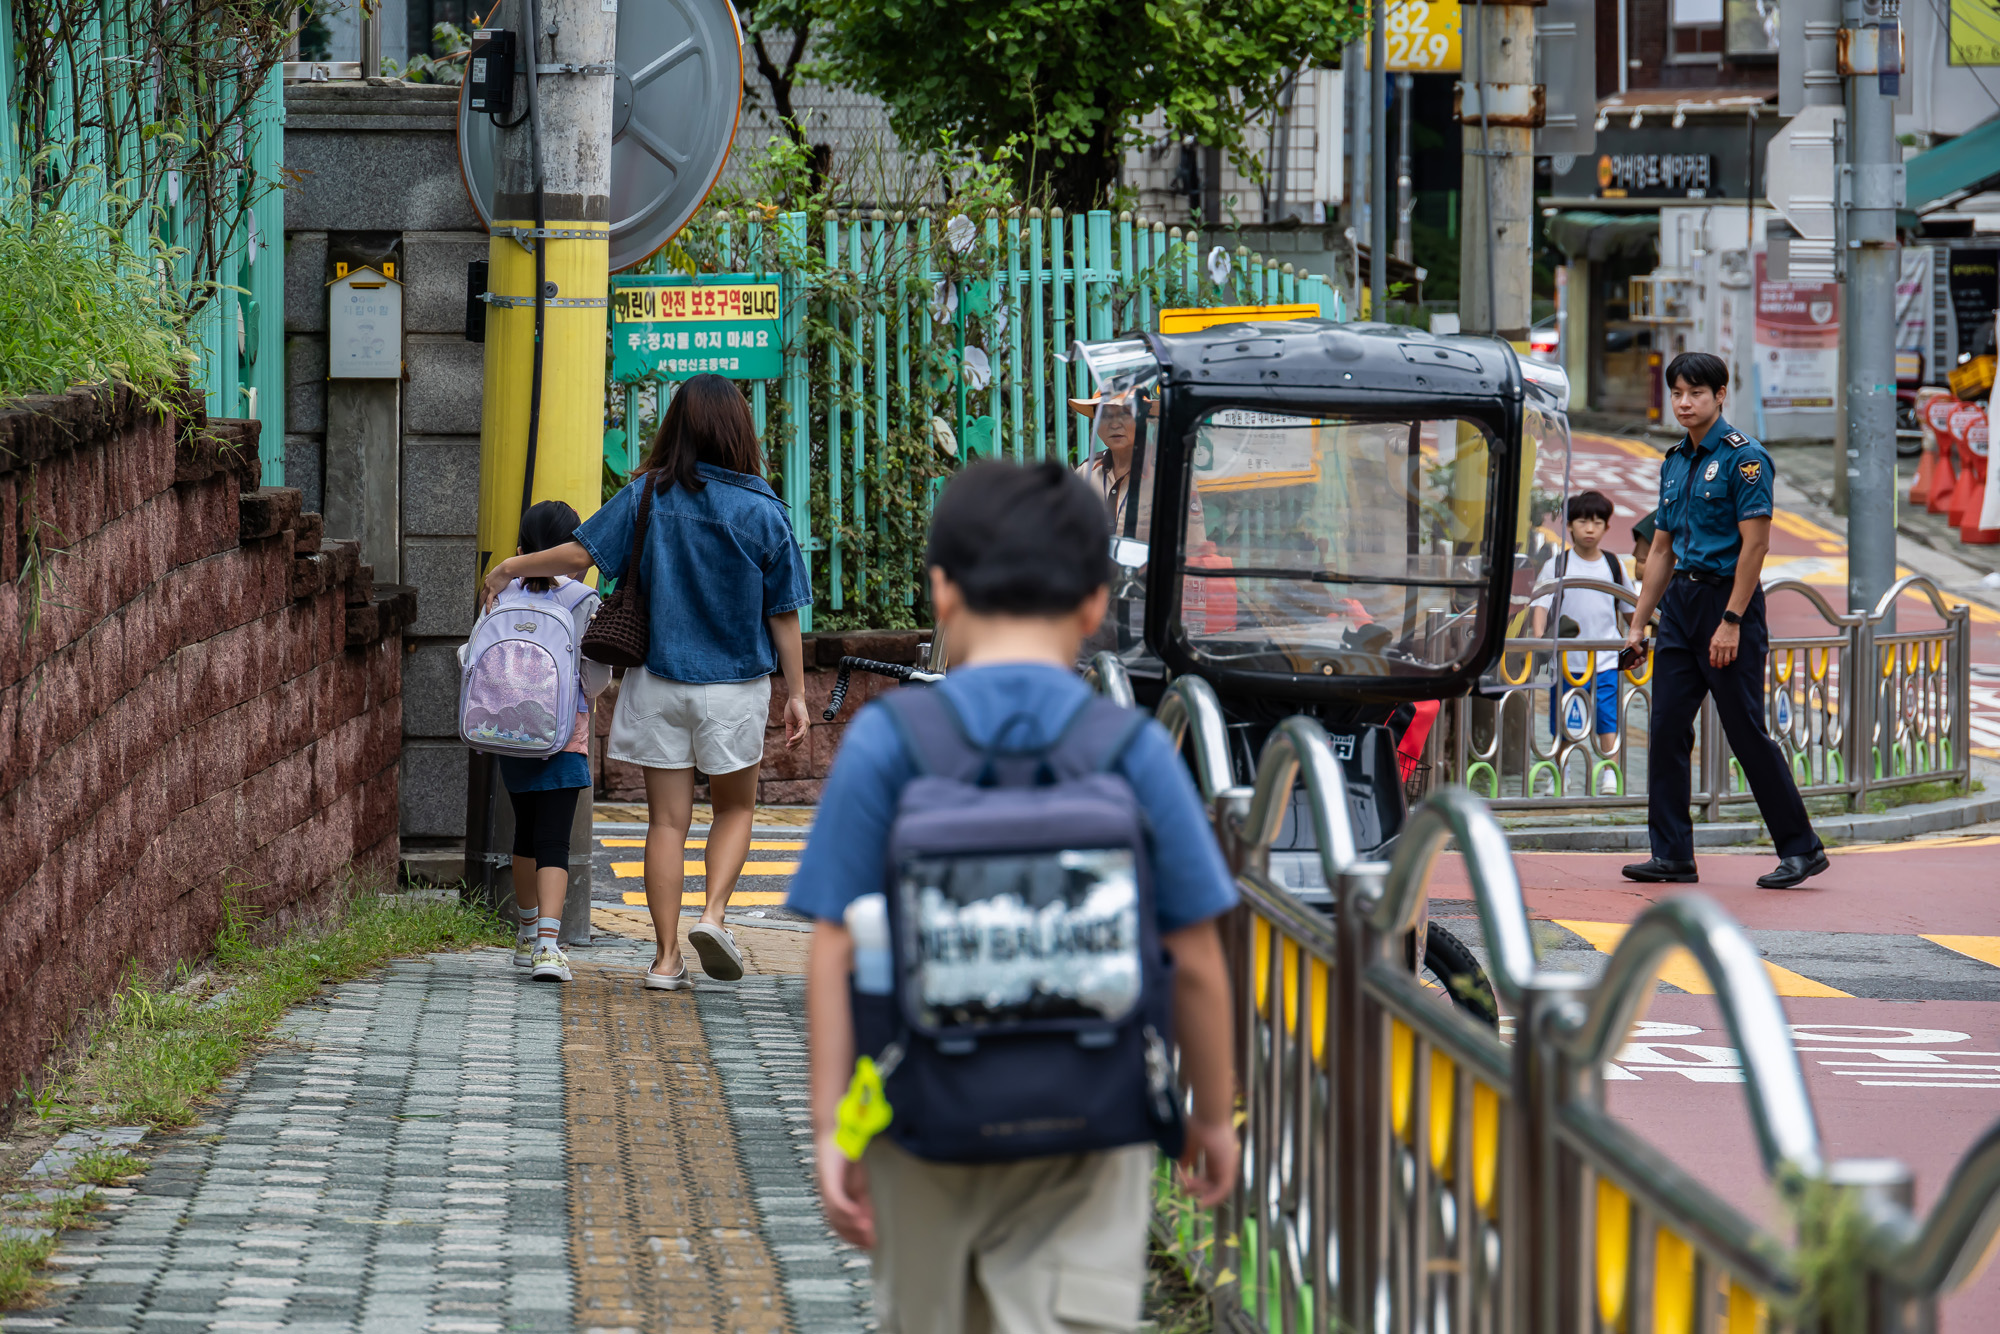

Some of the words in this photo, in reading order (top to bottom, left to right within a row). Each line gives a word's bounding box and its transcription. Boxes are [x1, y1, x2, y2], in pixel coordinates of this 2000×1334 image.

[660, 290, 686, 317] 안전
[691, 289, 777, 316] 보호구역입니다
[694, 331, 722, 350] 하지
[727, 330, 769, 349] 마세요
[657, 357, 740, 373] 서울연신초등학교
